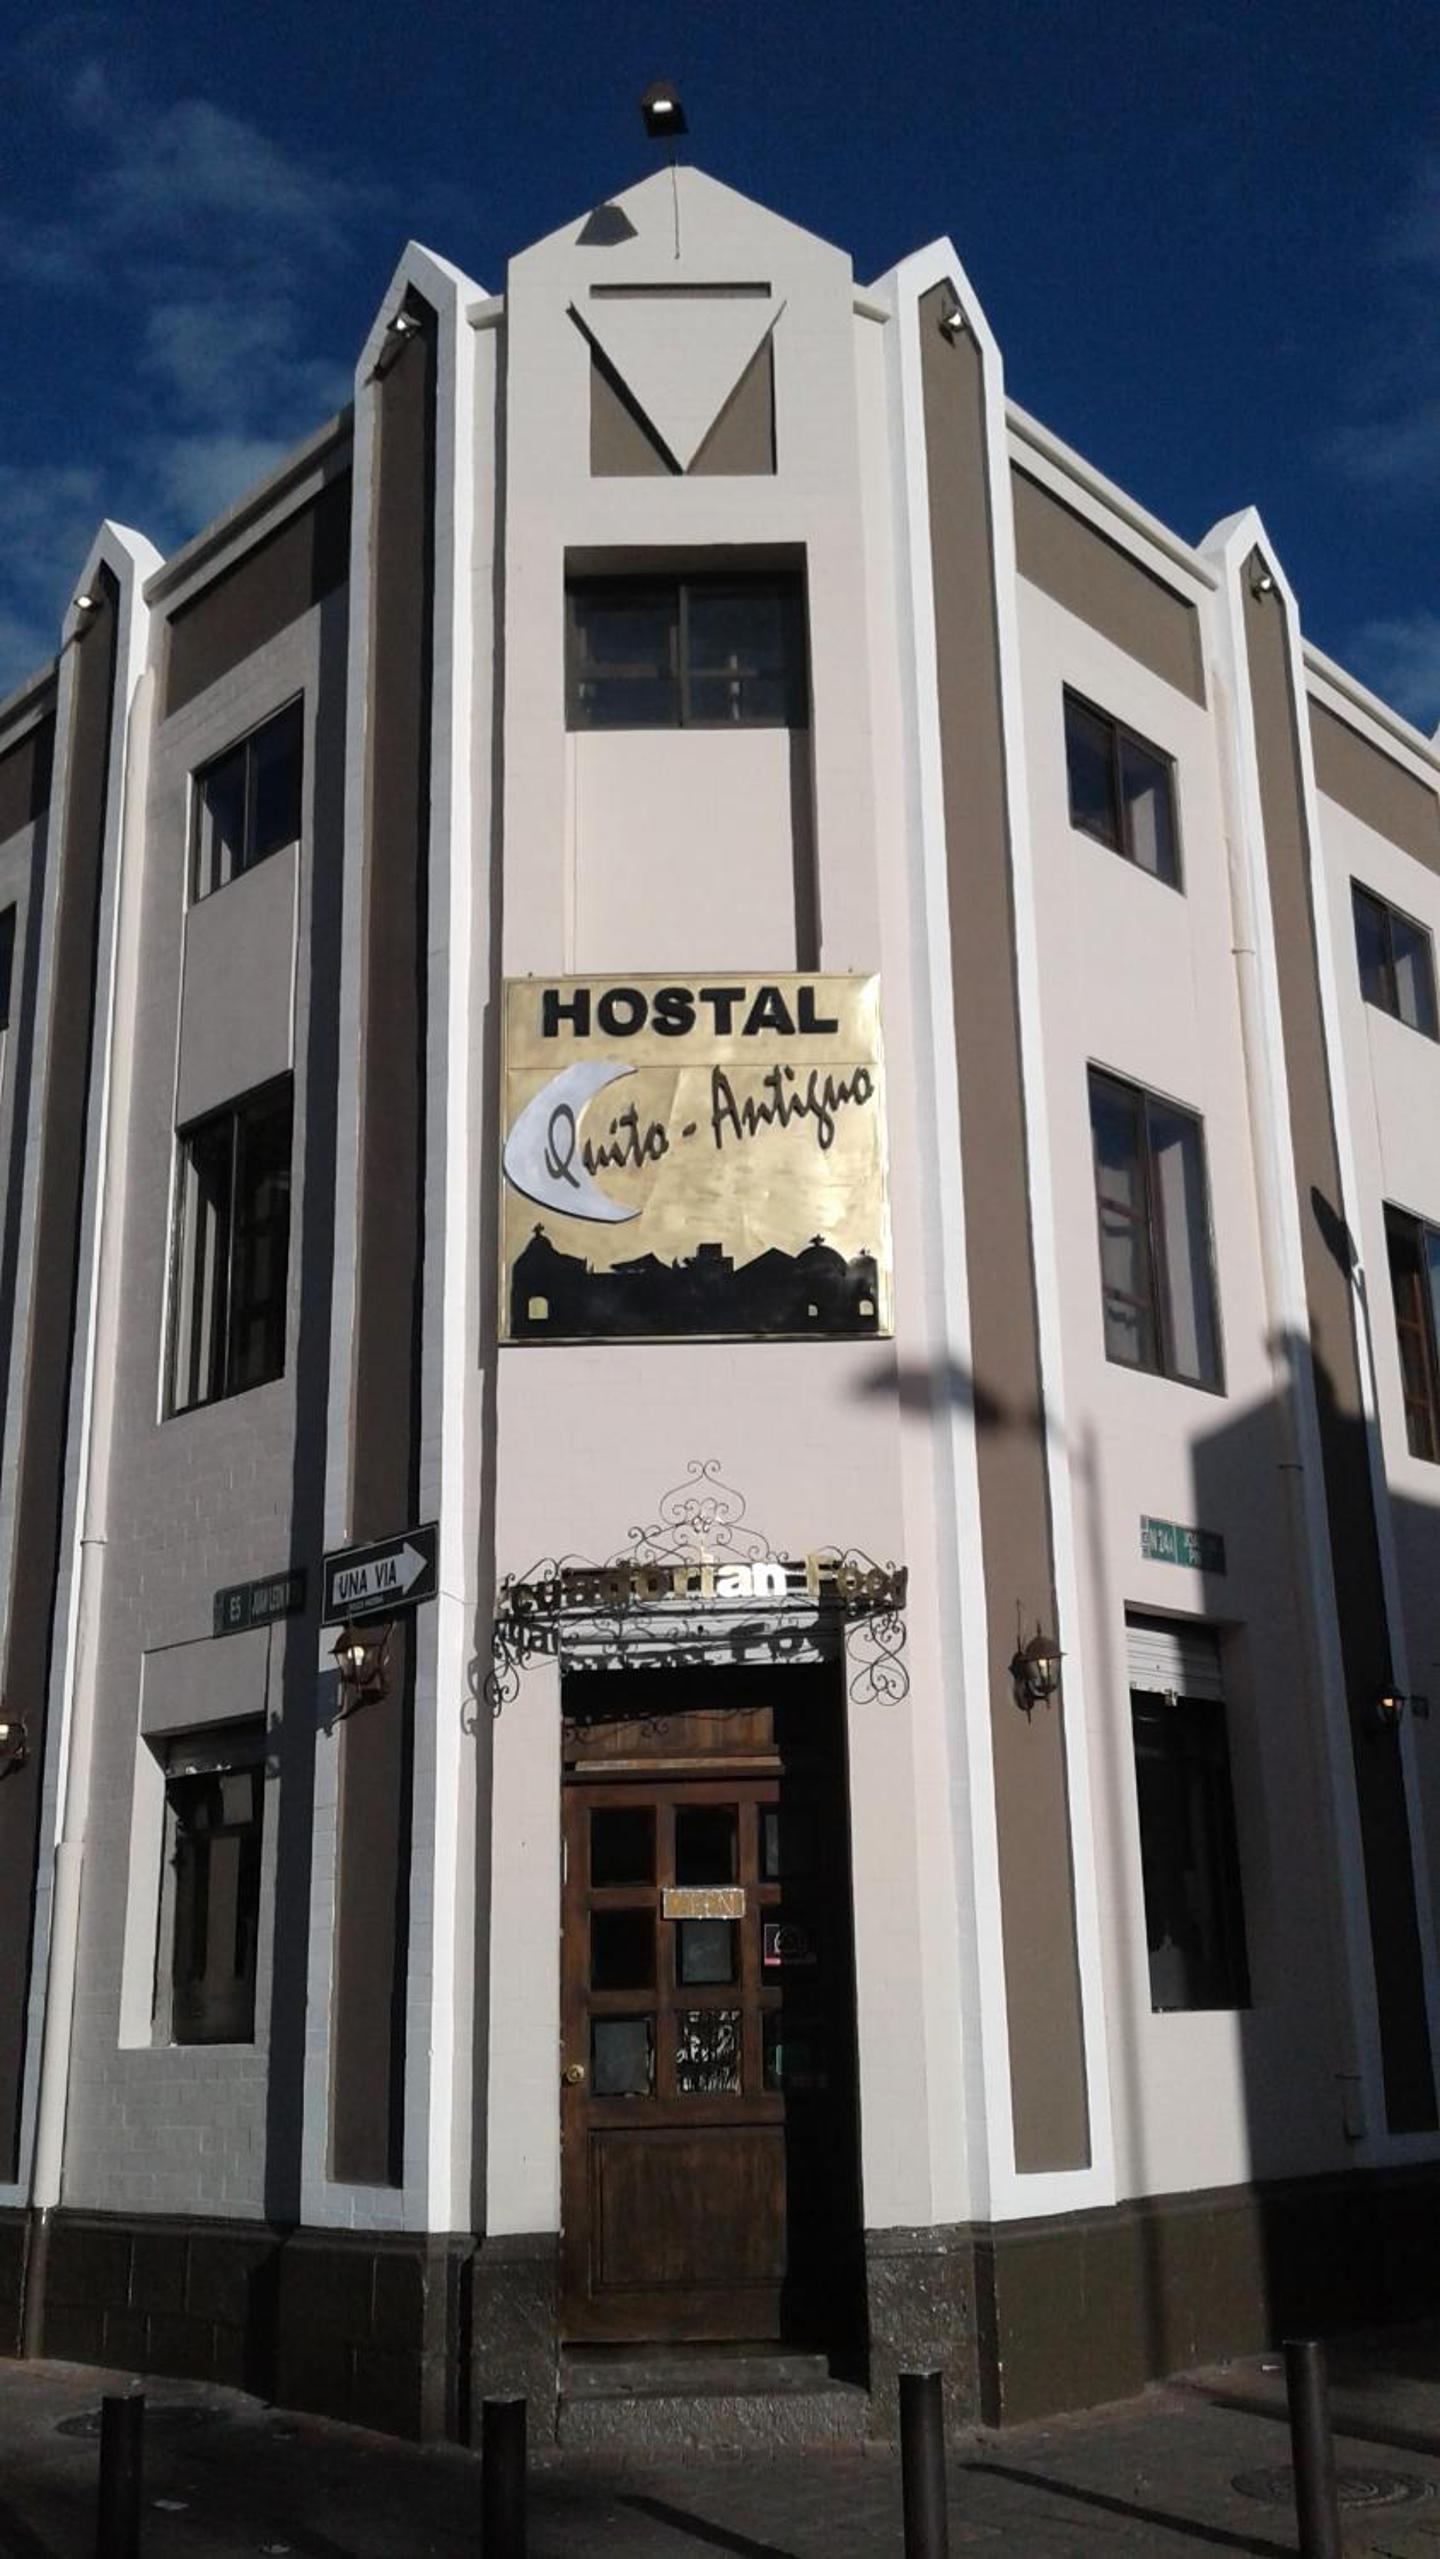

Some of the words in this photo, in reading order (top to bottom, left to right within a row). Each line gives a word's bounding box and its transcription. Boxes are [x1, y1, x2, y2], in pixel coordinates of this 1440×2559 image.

[542, 985, 839, 1038] HOSTAL
[545, 1103, 670, 1189] Quito
[711, 1064, 874, 1150] Antiguo
[339, 1571, 368, 1600] UNA
[374, 1559, 397, 1589] VIA
